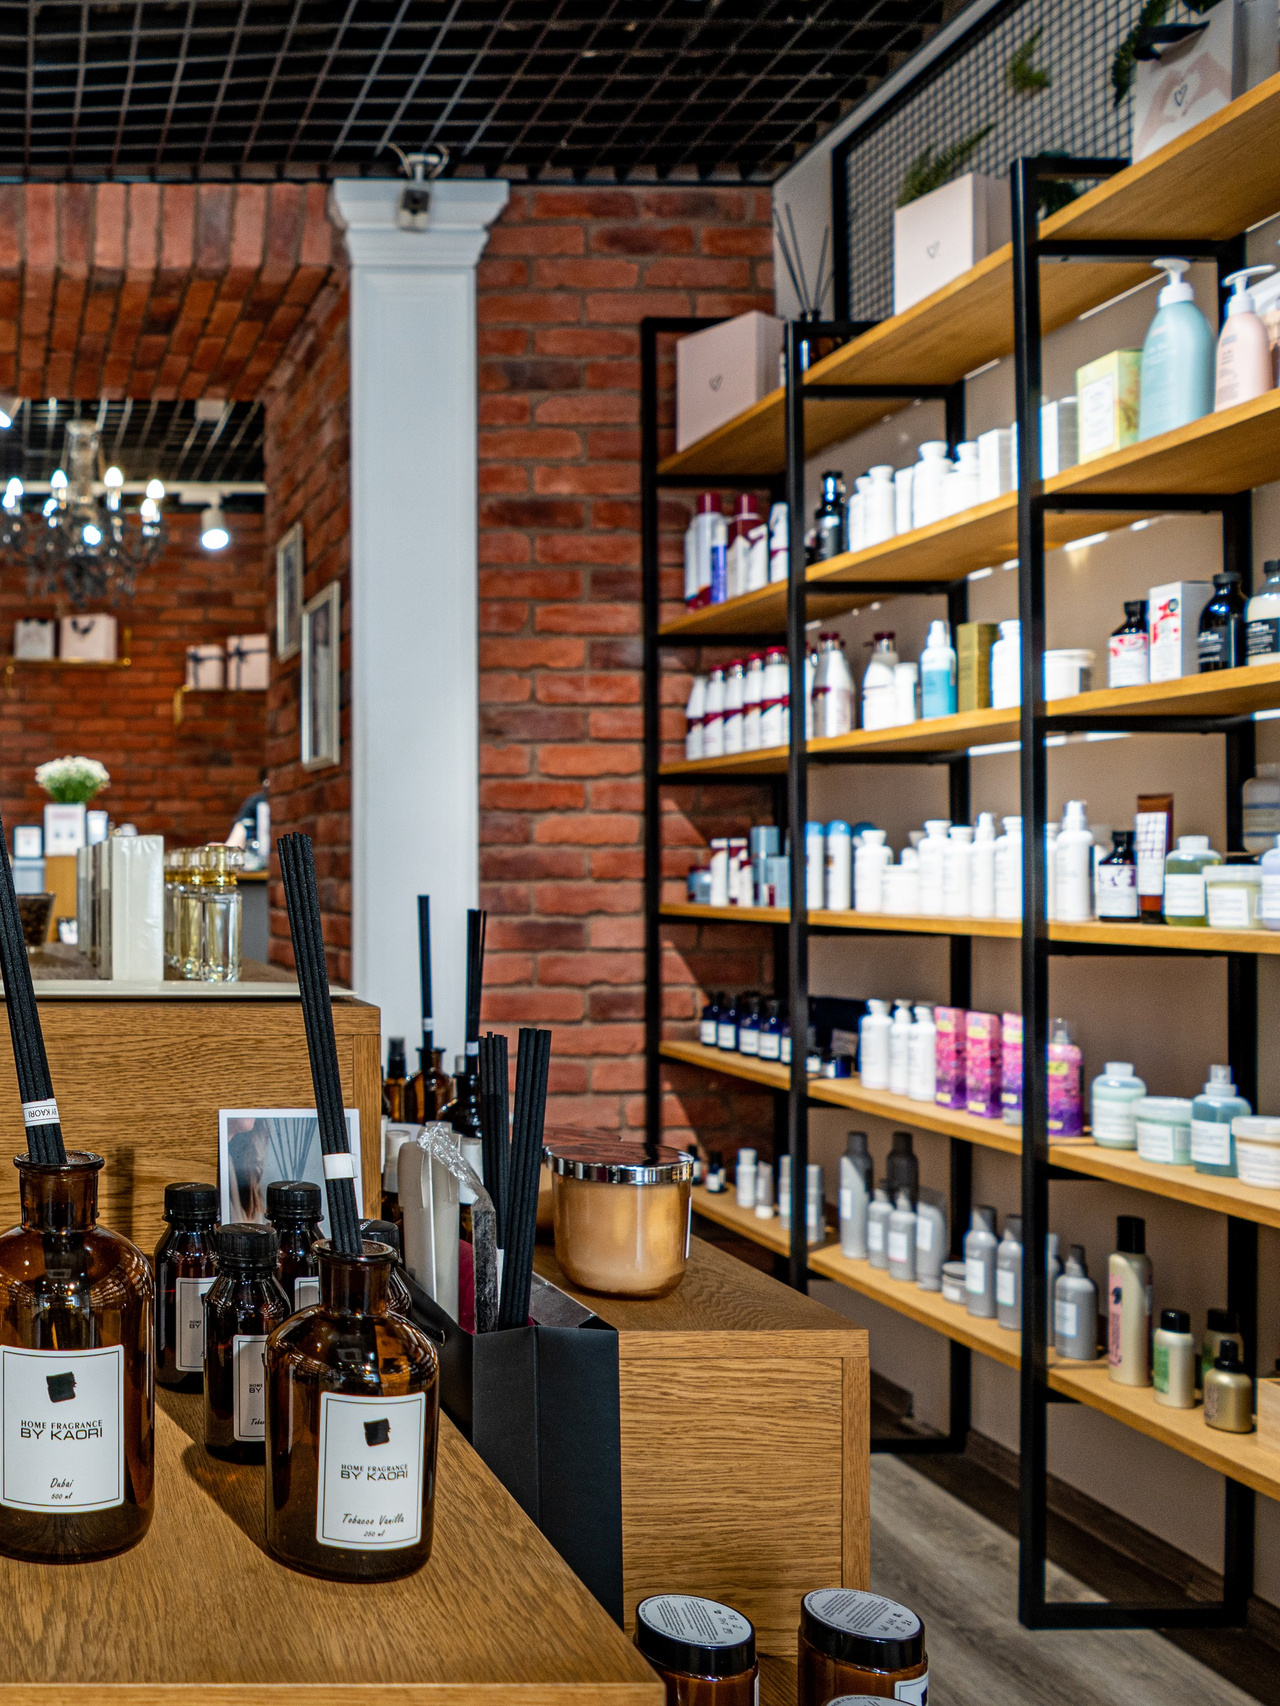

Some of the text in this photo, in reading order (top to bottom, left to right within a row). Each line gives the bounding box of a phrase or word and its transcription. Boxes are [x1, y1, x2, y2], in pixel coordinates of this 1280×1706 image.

[28, 1109, 50, 1118] KAORI
[21, 1420, 103, 1430] HOME FRAGRANCE
[21, 1428, 103, 1440] BY KAORI
[341, 1470, 408, 1481] BY KAORI
[50, 1478, 74, 1488] Dubai
[342, 1513, 404, 1525] Tobacco Vanilla
